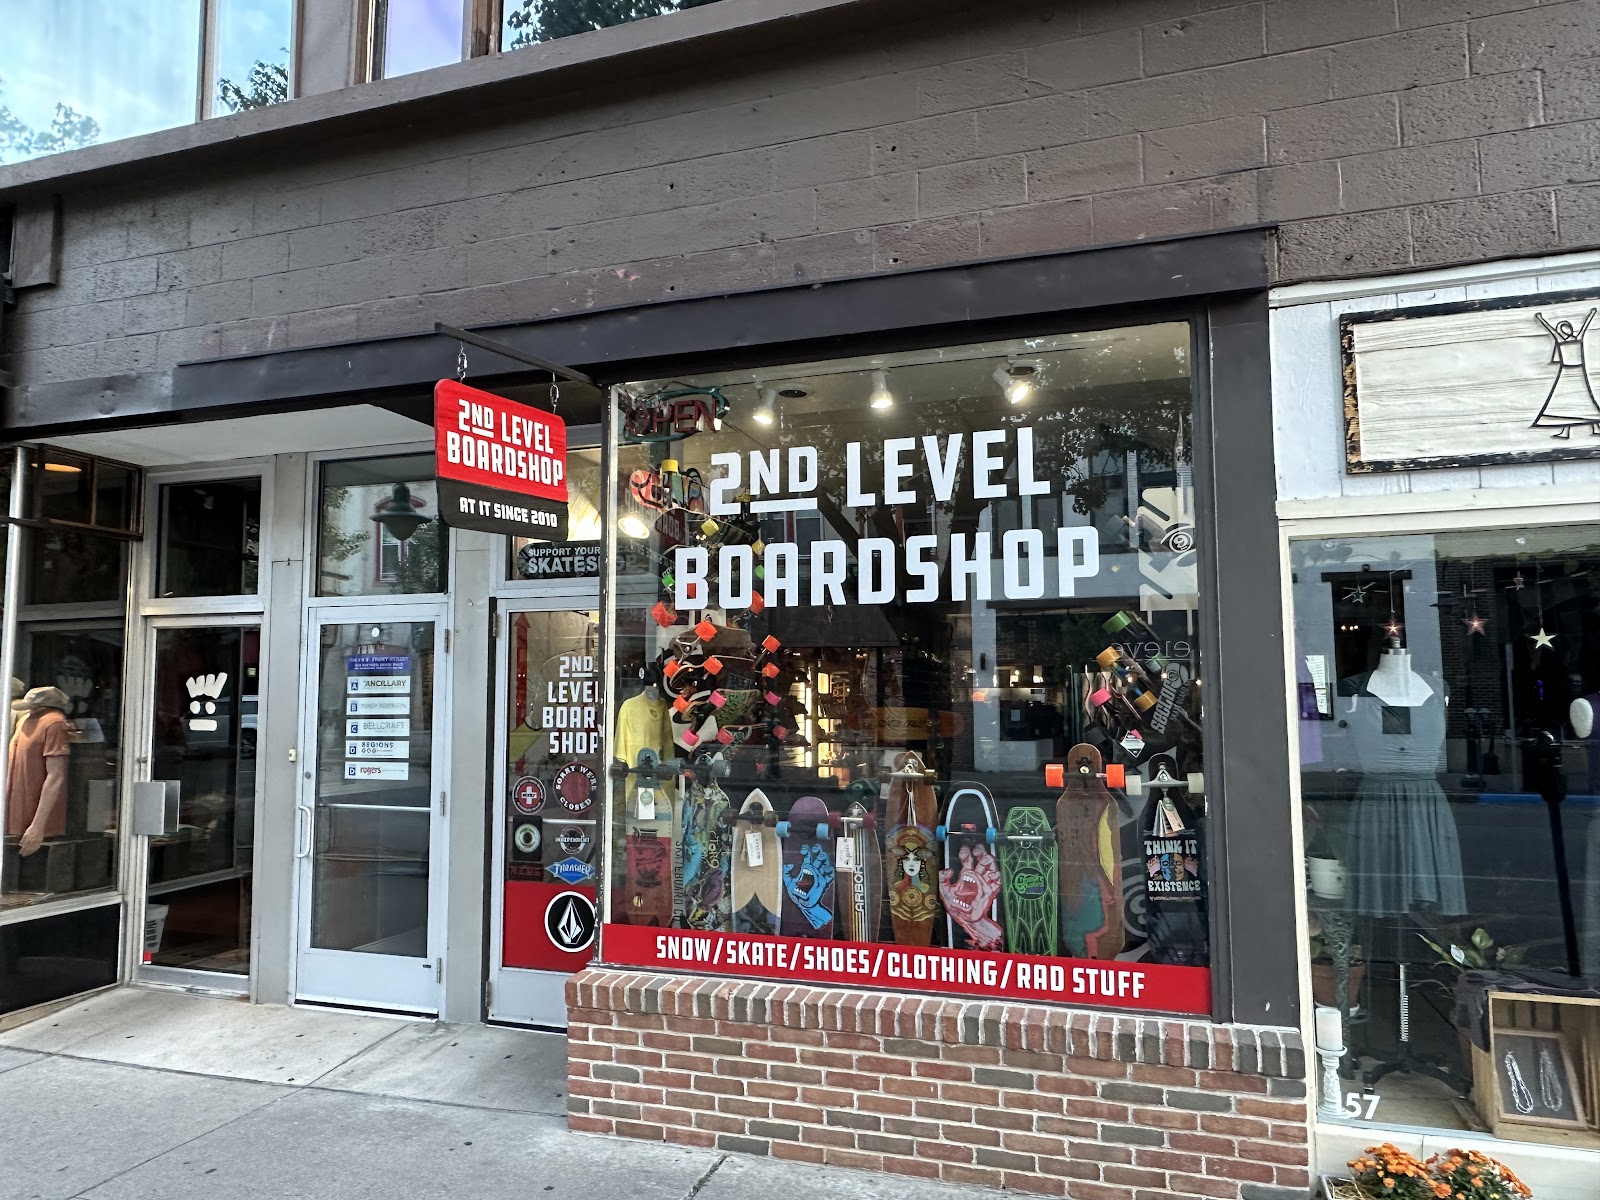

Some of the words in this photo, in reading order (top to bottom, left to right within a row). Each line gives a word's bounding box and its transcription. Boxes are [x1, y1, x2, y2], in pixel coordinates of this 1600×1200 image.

[458, 399, 494, 438] 2ND
[501, 412, 554, 454] LEVEL
[624, 399, 719, 437] OPEN
[447, 431, 563, 487] BOARDSHOP
[709, 445, 818, 516] 2ND
[846, 426, 1051, 508] LEVEL
[459, 496, 476, 514] AT
[479, 500, 491, 517] IT
[493, 503, 529, 523] SINCE
[531, 510, 558, 528] 2010
[528, 547, 571, 557] SUPPORT
[574, 546, 600, 555] YOUR
[528, 556, 600, 573] SKATES
[674, 525, 1100, 611] BOARDSHOP
[559, 656, 593, 678] 2ND
[549, 731, 598, 754] SHOP
[556, 765, 576, 790] SORRY
[580, 765, 597, 791] WE'RE
[560, 796, 592, 811] CLOSED
[1144, 839, 1182, 856] THINK
[1185, 839, 1198, 855] IT
[554, 862, 592, 877] THRASHER
[853, 863, 864, 912] ARBOR
[1148, 880, 1201, 892] EXISTENCE
[1072, 967, 1146, 999] STUFF
[1346, 1092, 1381, 1120] 57
